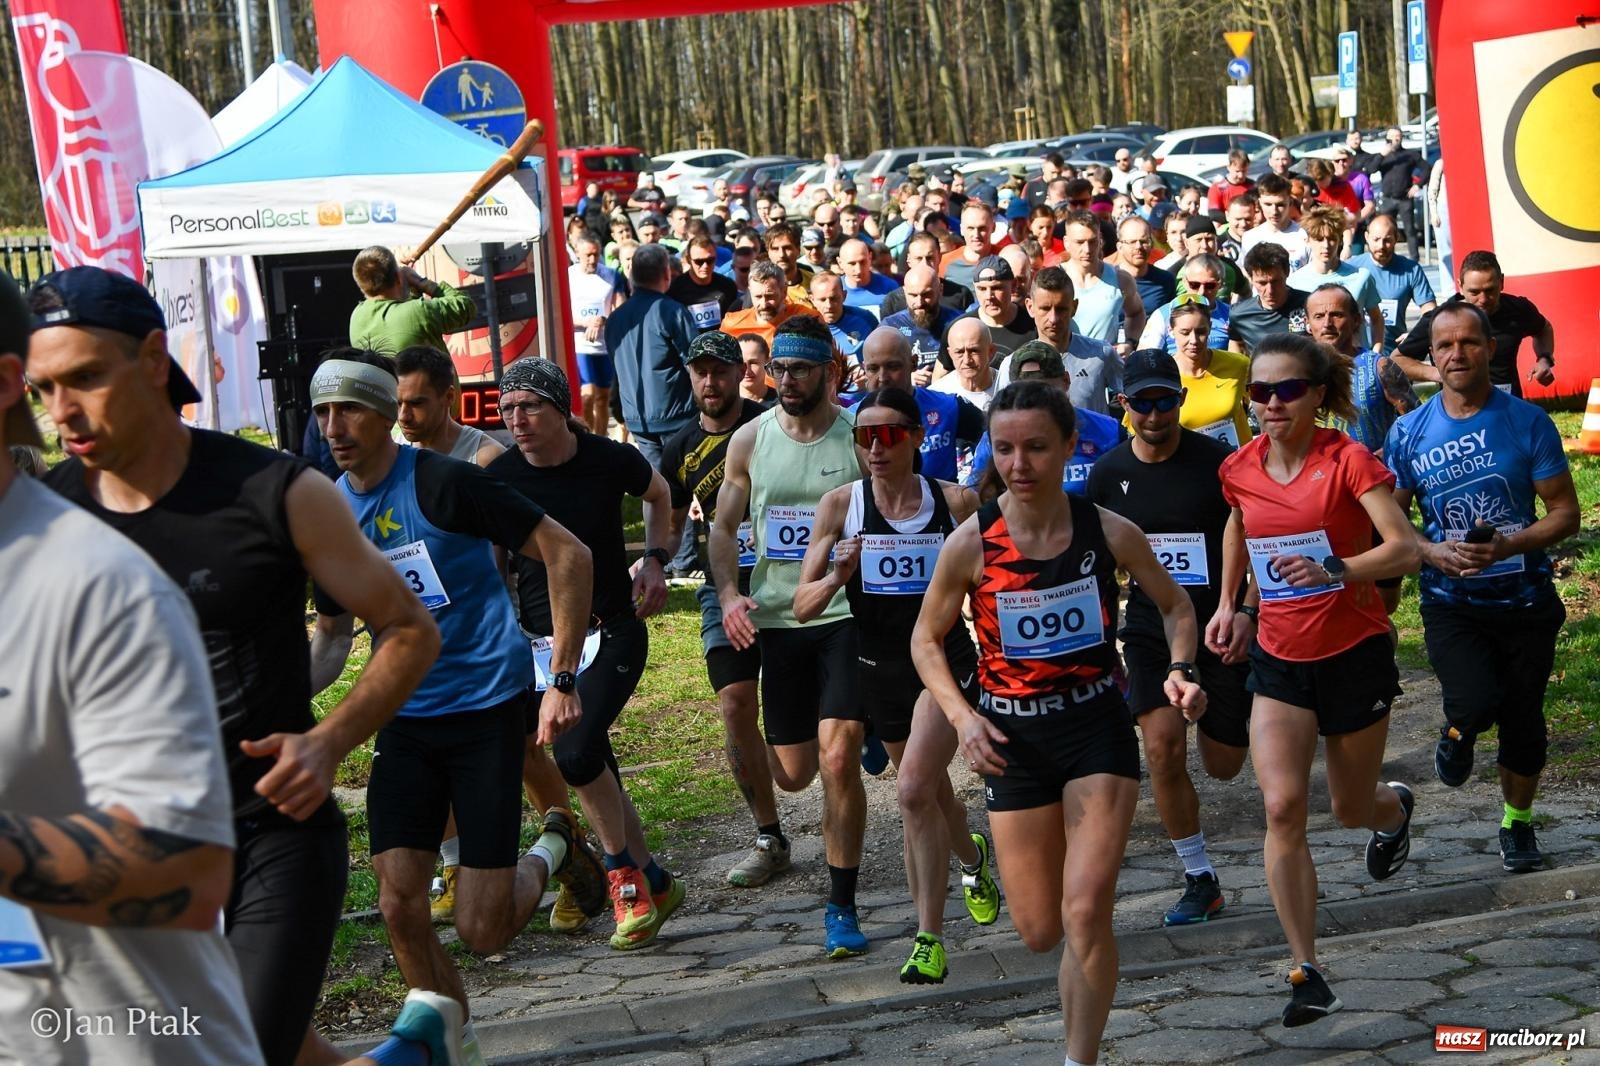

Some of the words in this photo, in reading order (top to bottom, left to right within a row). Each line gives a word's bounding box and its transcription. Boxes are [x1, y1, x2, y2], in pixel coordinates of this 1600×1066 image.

[1410, 7, 1422, 46] P
[1341, 38, 1354, 74] P
[170, 208, 310, 235] PersonalBest
[473, 205, 509, 217] MITKO
[580, 308, 600, 318] 057
[695, 311, 715, 322] 001
[1411, 428, 1487, 477] MORSY
[1421, 451, 1497, 492] RACIBÓRZ
[898, 538, 938, 546] TWARDZIELA
[1279, 536, 1321, 549] TWARDZIELA
[878, 555, 926, 579] 031
[1003, 597, 1017, 605] XIV
[1020, 596, 1040, 604] BIEG
[1042, 583, 1091, 602] TWARDZIELA
[1016, 607, 1086, 641] 090
